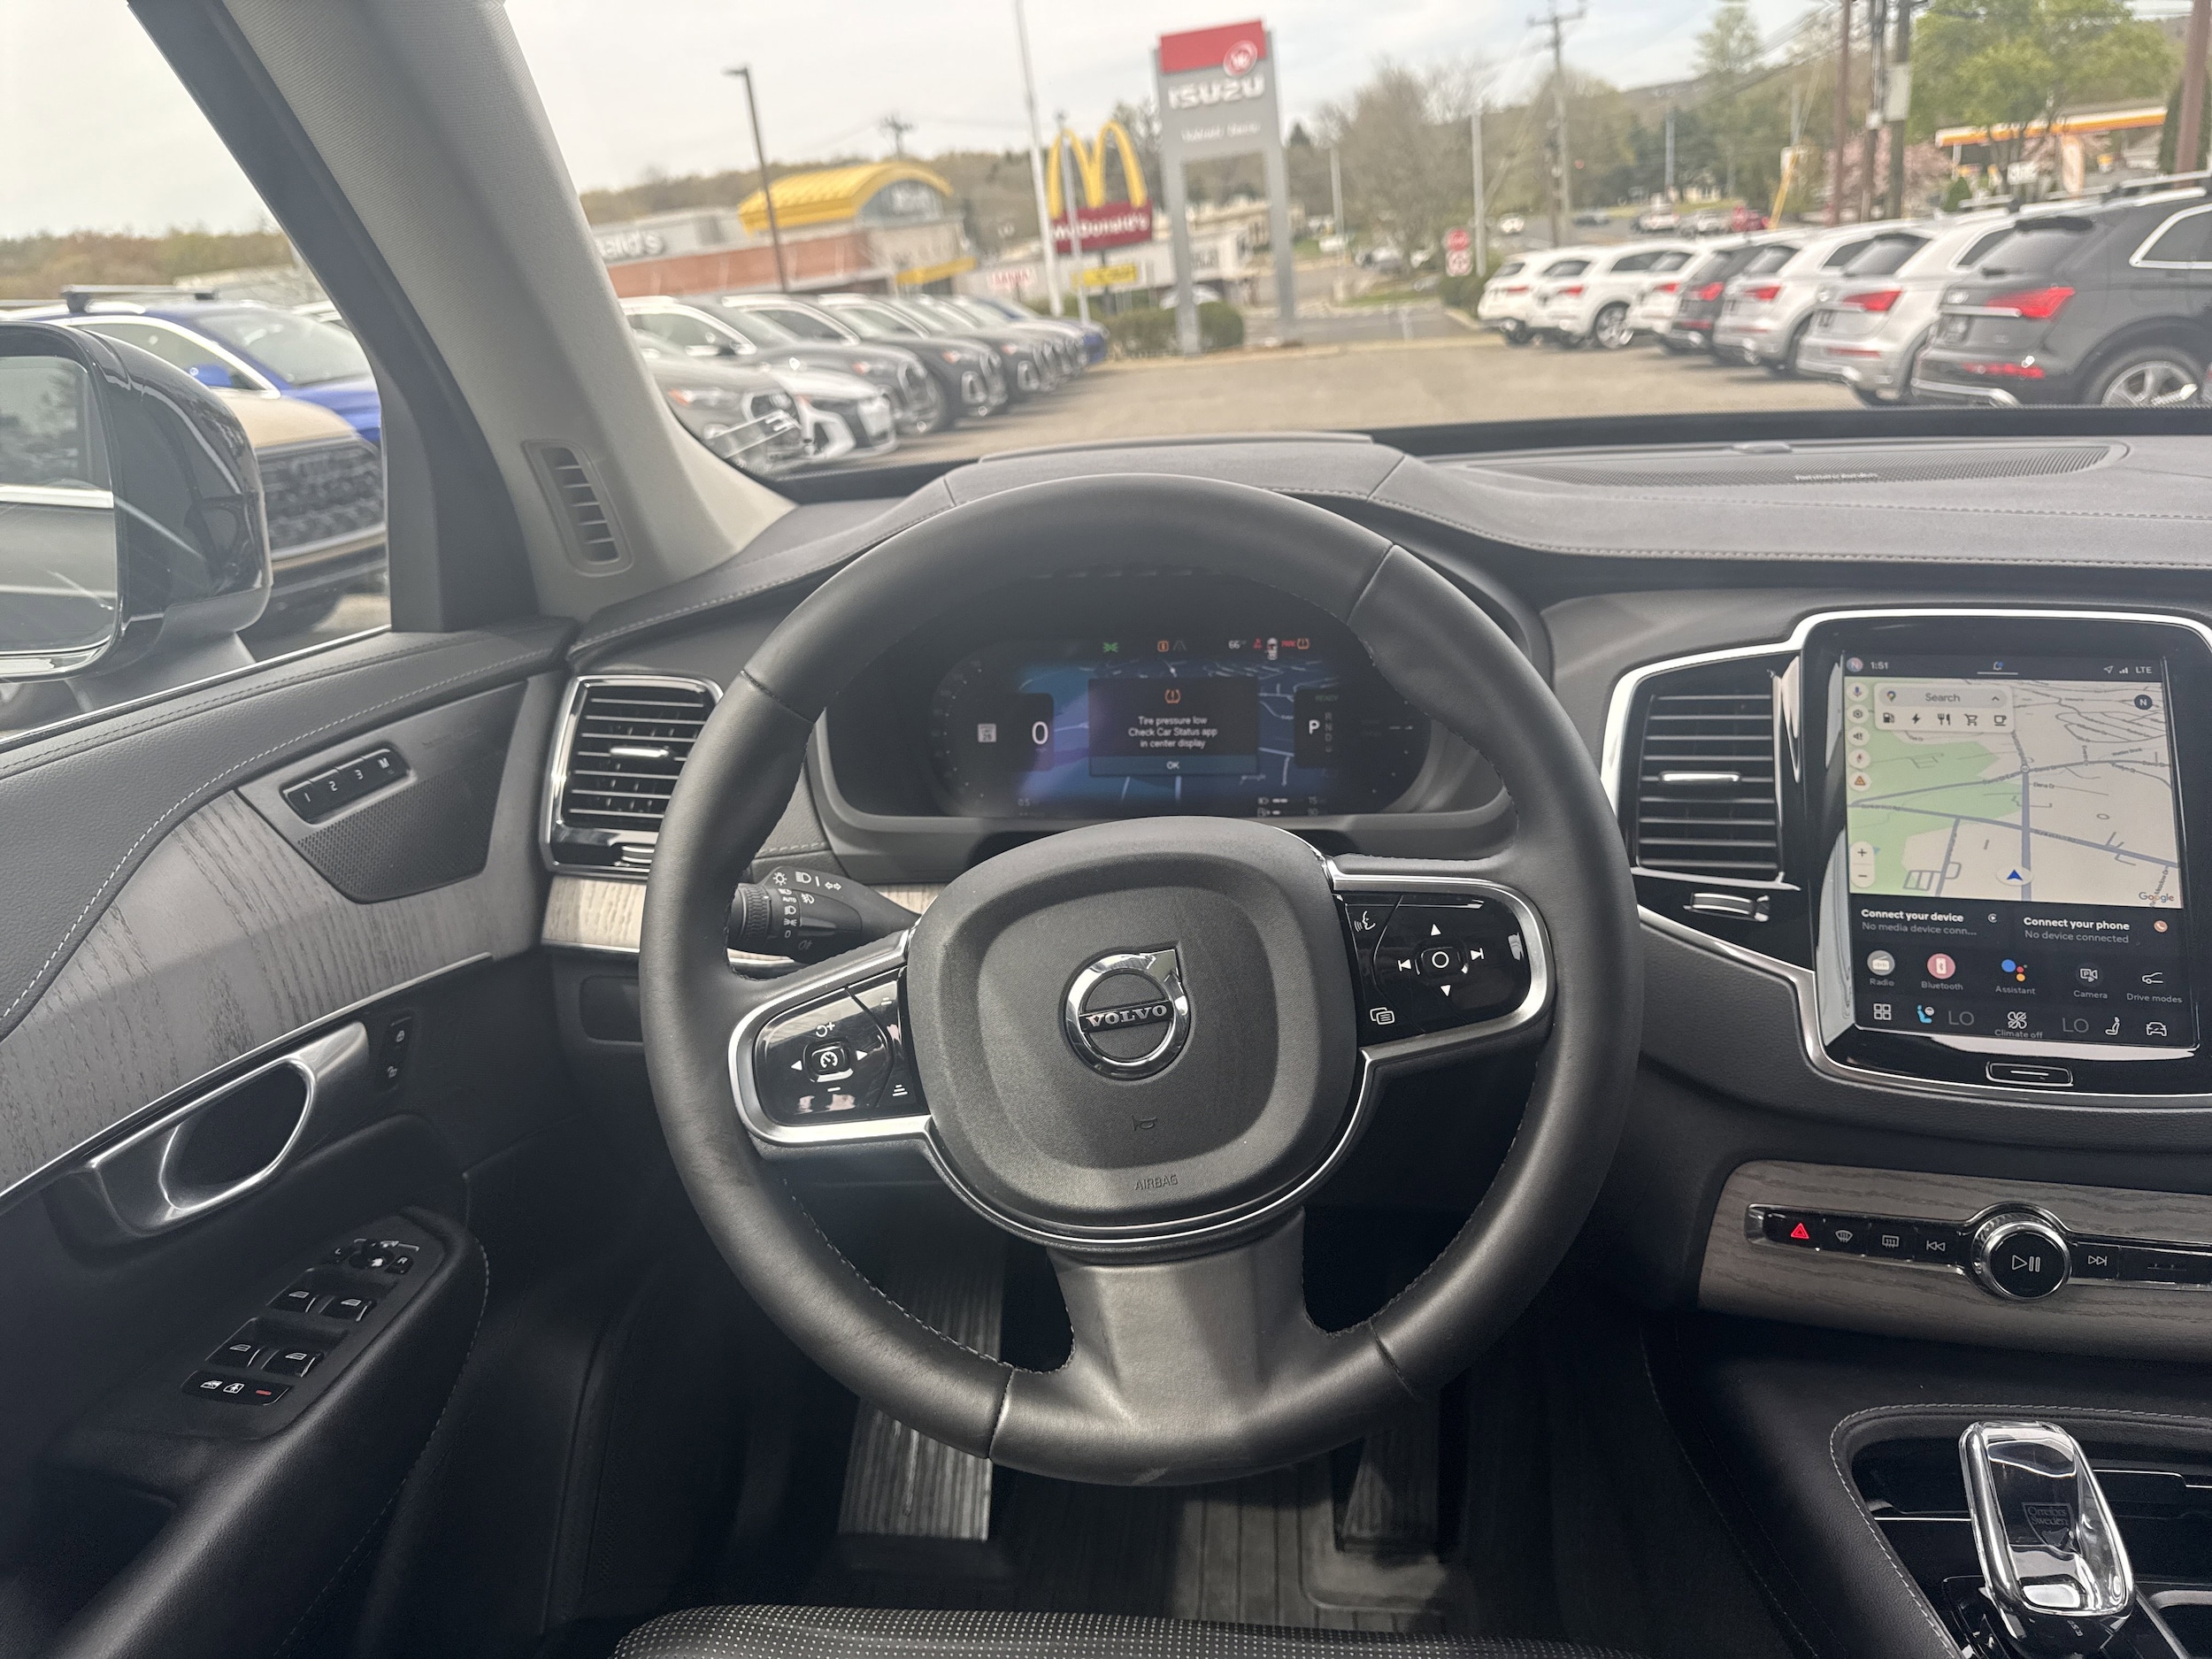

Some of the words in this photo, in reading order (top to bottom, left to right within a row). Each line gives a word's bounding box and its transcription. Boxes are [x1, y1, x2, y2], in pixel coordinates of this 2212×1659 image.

[1167, 73, 1265, 110] ISUZU
[1870, 661, 1888, 670] 1:51
[2135, 665, 2153, 675] LTE
[1925, 693, 1961, 703] Search
[1138, 716, 1154, 725] Tire
[1156, 718, 1191, 726] pressure
[1193, 716, 1208, 725] low
[1309, 719, 1320, 734] P
[1032, 721, 1048, 744] 0
[1128, 727, 1155, 736] Check
[1156, 727, 1171, 736] Car
[1173, 727, 1200, 736] Status
[1202, 728, 1217, 738] app
[1178, 739, 1206, 749] display
[1166, 761, 1179, 770] OK
[355, 769, 364, 780] 3
[328, 780, 338, 791] 2
[2139, 892, 2175, 902] Google
[1861, 909, 1904, 919] Connect
[1906, 912, 1929, 922] your
[1931, 912, 1964, 922] device
[1878, 923, 1908, 932] media
[1910, 924, 1941, 933] device
[2024, 917, 2068, 927] Connect
[2070, 919, 2094, 930] your
[2096, 921, 2130, 931] phone
[2024, 930, 2040, 939] No
[2042, 931, 2074, 941] device
[2076, 933, 2130, 943] connected
[1870, 978, 1894, 987] Radio
[1921, 980, 1963, 990] Bluetooth
[1995, 985, 2035, 995] Assistant
[2073, 990, 2108, 999] Camera
[2126, 993, 2150, 1002] Drive
[2152, 995, 2183, 1003] modes
[1085, 1003, 1168, 1027] VOLVO
[1947, 1010, 1975, 1026] LO
[2062, 1018, 2089, 1033] LO
[1994, 1029, 2029, 1038] Climate
[1134, 1175, 1179, 1191] AIRBAG
[2030, 1516, 2070, 1525] Sweden
